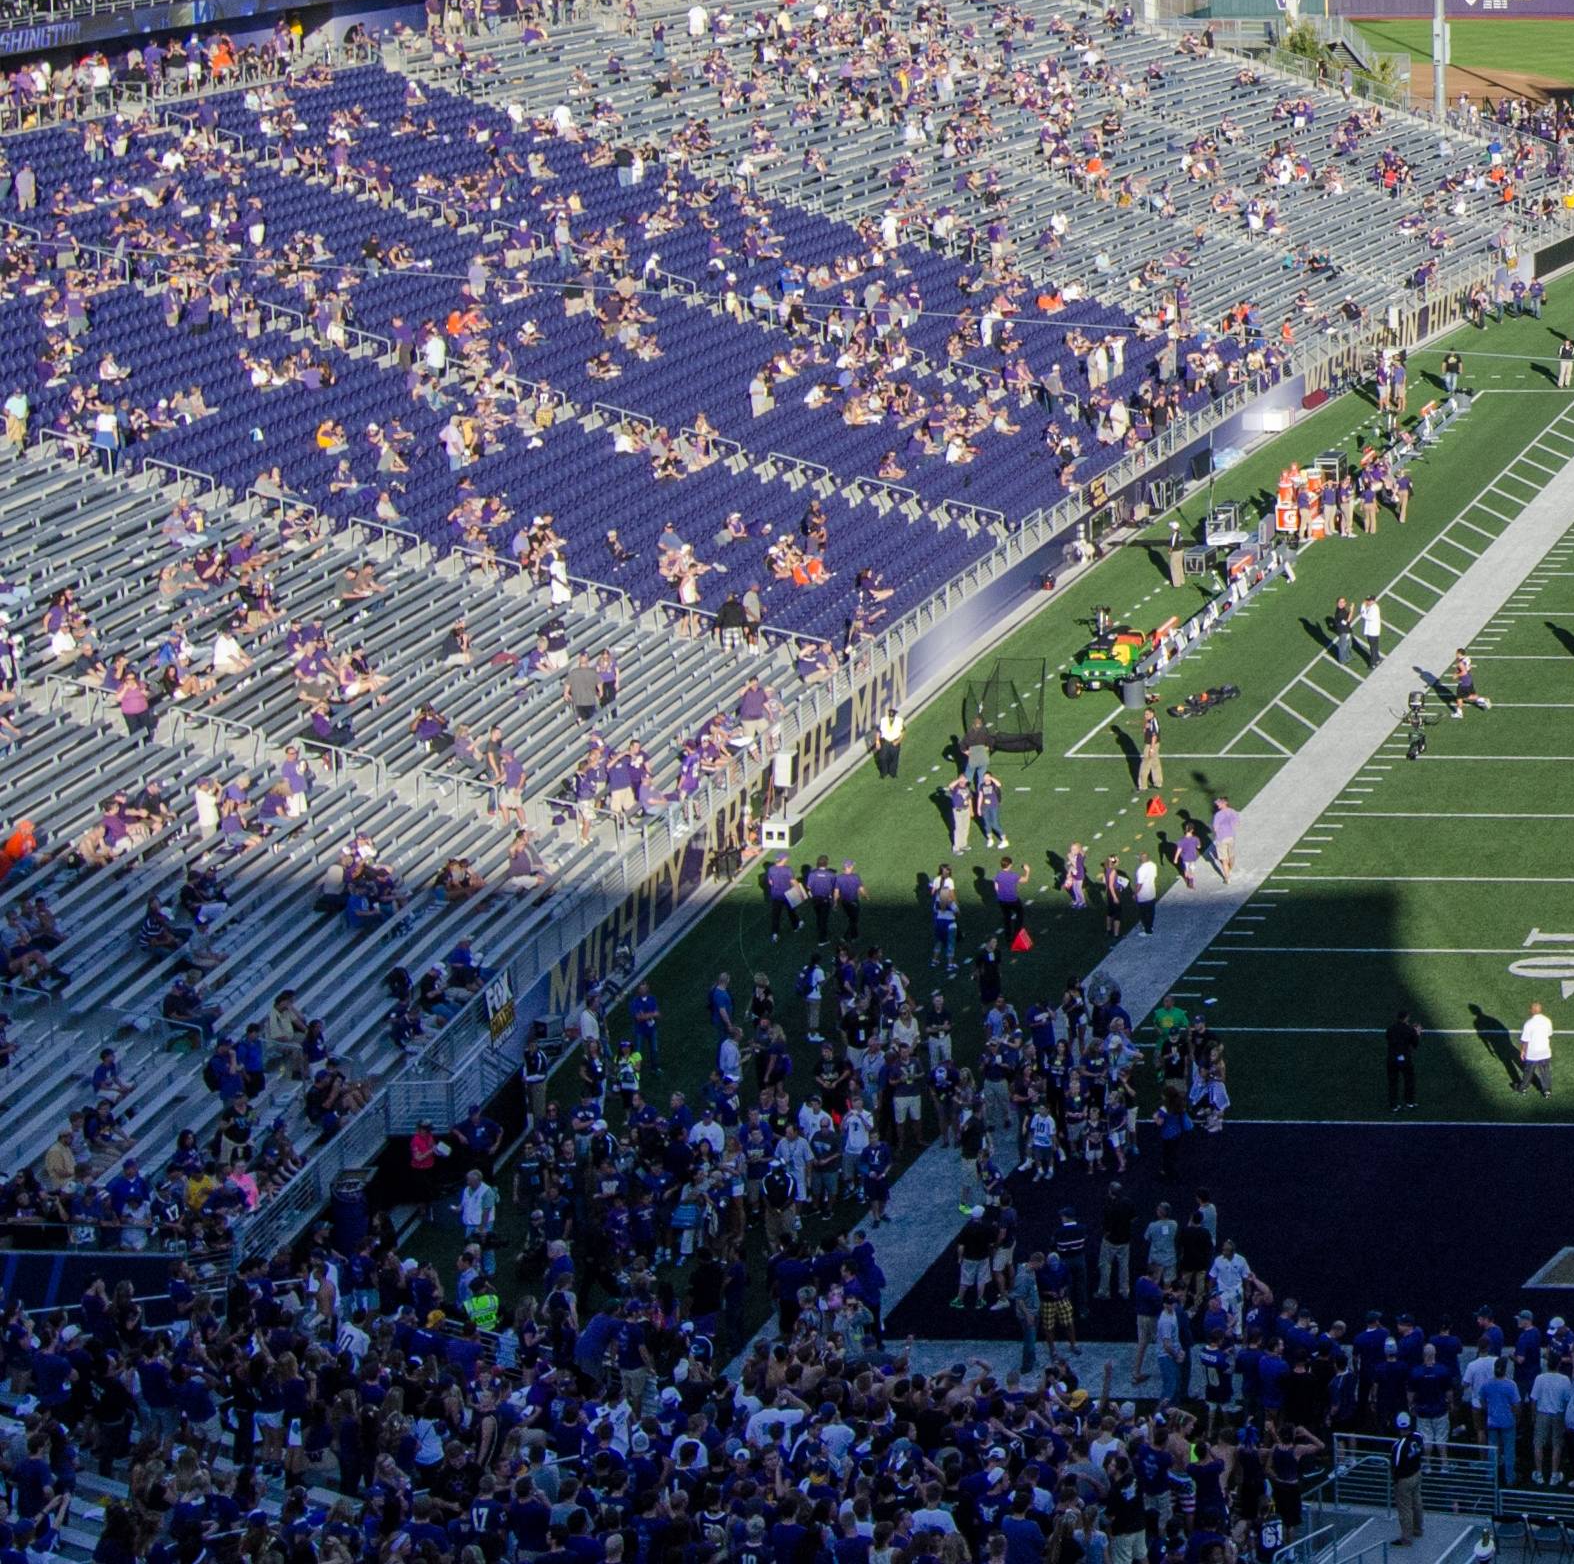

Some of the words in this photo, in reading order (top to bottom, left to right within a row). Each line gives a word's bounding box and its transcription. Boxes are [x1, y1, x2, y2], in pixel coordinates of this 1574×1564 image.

[1284, 510, 1297, 526] G
[852, 650, 908, 745] MEN
[485, 971, 512, 1019] FOX
[166, 1204, 179, 1221] 17
[472, 1507, 489, 1532] 17
